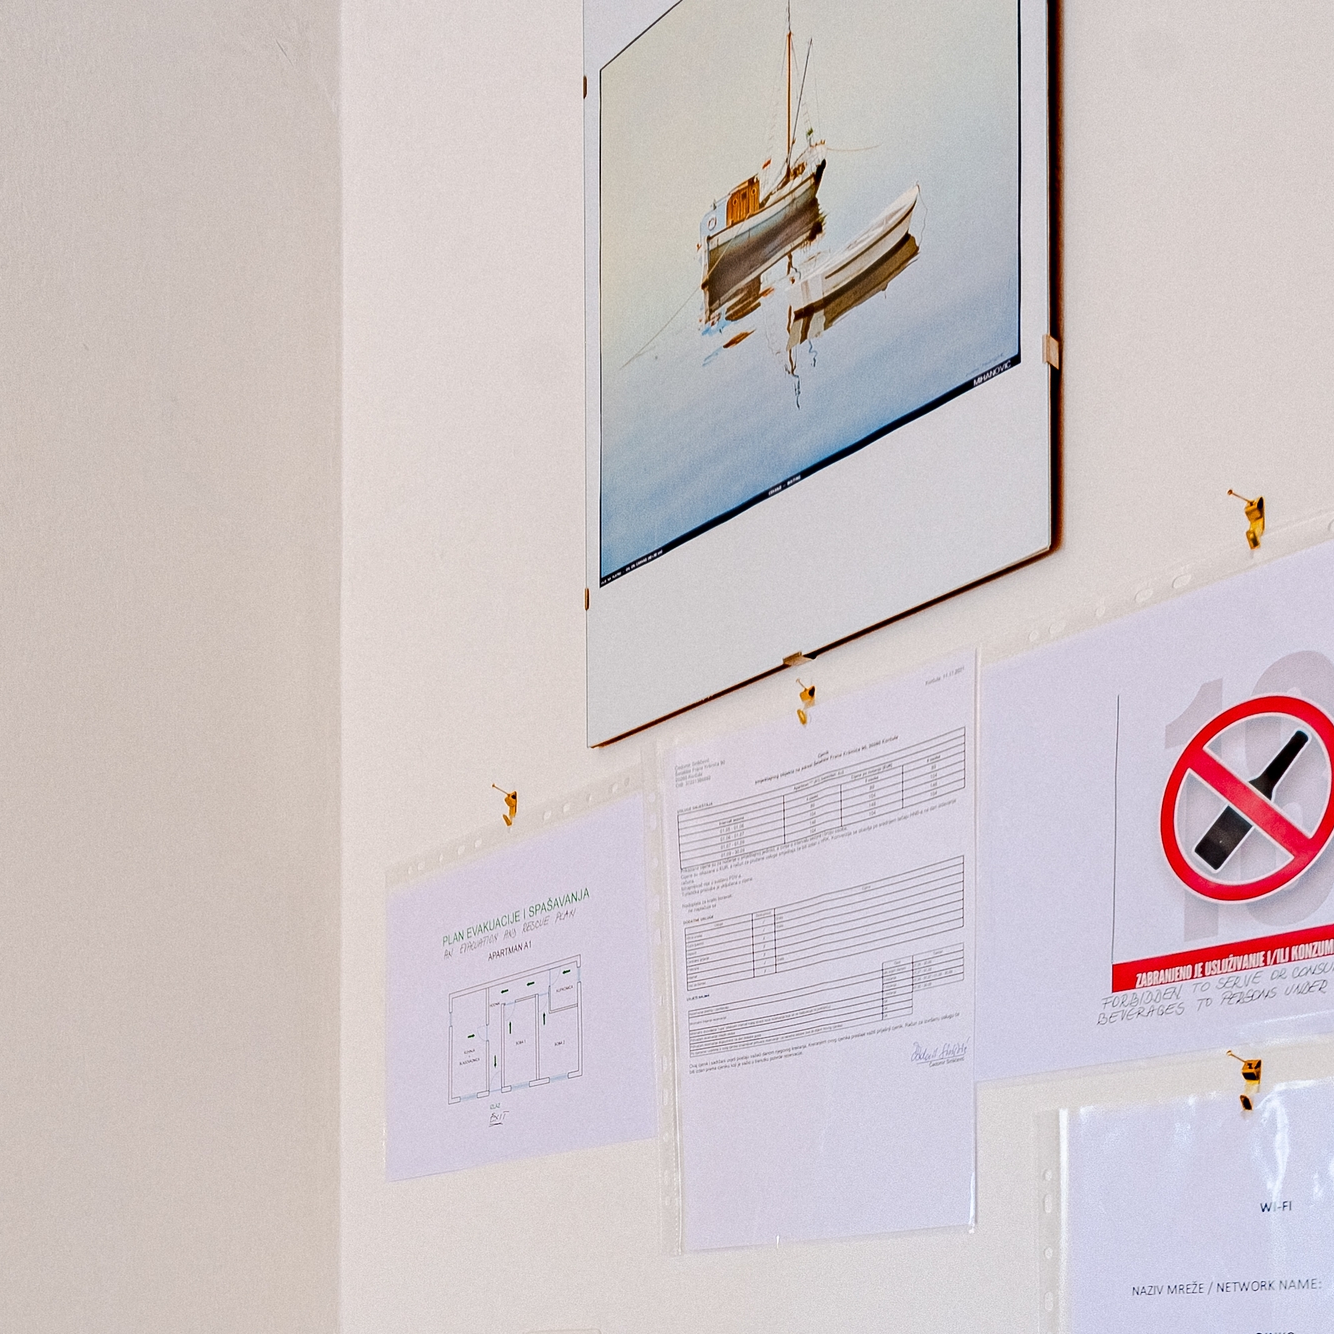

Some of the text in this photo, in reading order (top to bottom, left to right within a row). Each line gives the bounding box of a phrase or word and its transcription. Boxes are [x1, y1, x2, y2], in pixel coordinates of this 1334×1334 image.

[442, 887, 590, 947] PLAN EVAKUACIJE I SPAŠAVANJA
[487, 940, 533, 962] APARTMAN A1
[1135, 964, 1193, 990] ZABRANJENO
[1193, 961, 1204, 979] JE
[1204, 950, 1267, 977] USLUŽIVANJE
[1266, 946, 1291, 967] I/ILI
[1097, 1001, 1186, 1027] BEVERAGES
[1197, 997, 1214, 1013] TO
[1219, 986, 1278, 1007] PERSONS
[1284, 979, 1329, 997] UNDER
[1102, 983, 1184, 1011] FORBIDDEN
[1192, 981, 1211, 995] TO
[1216, 969, 1265, 991] SERVE
[1270, 967, 1289, 982] OR
[1260, 1201, 1293, 1213] WI-FI
[1132, 1284, 1165, 1296] NAZIV
[1167, 1281, 1205, 1295] MREŽE
[1216, 1279, 1276, 1293] NETWORK
[1279, 1278, 1323, 1291] NAME:
